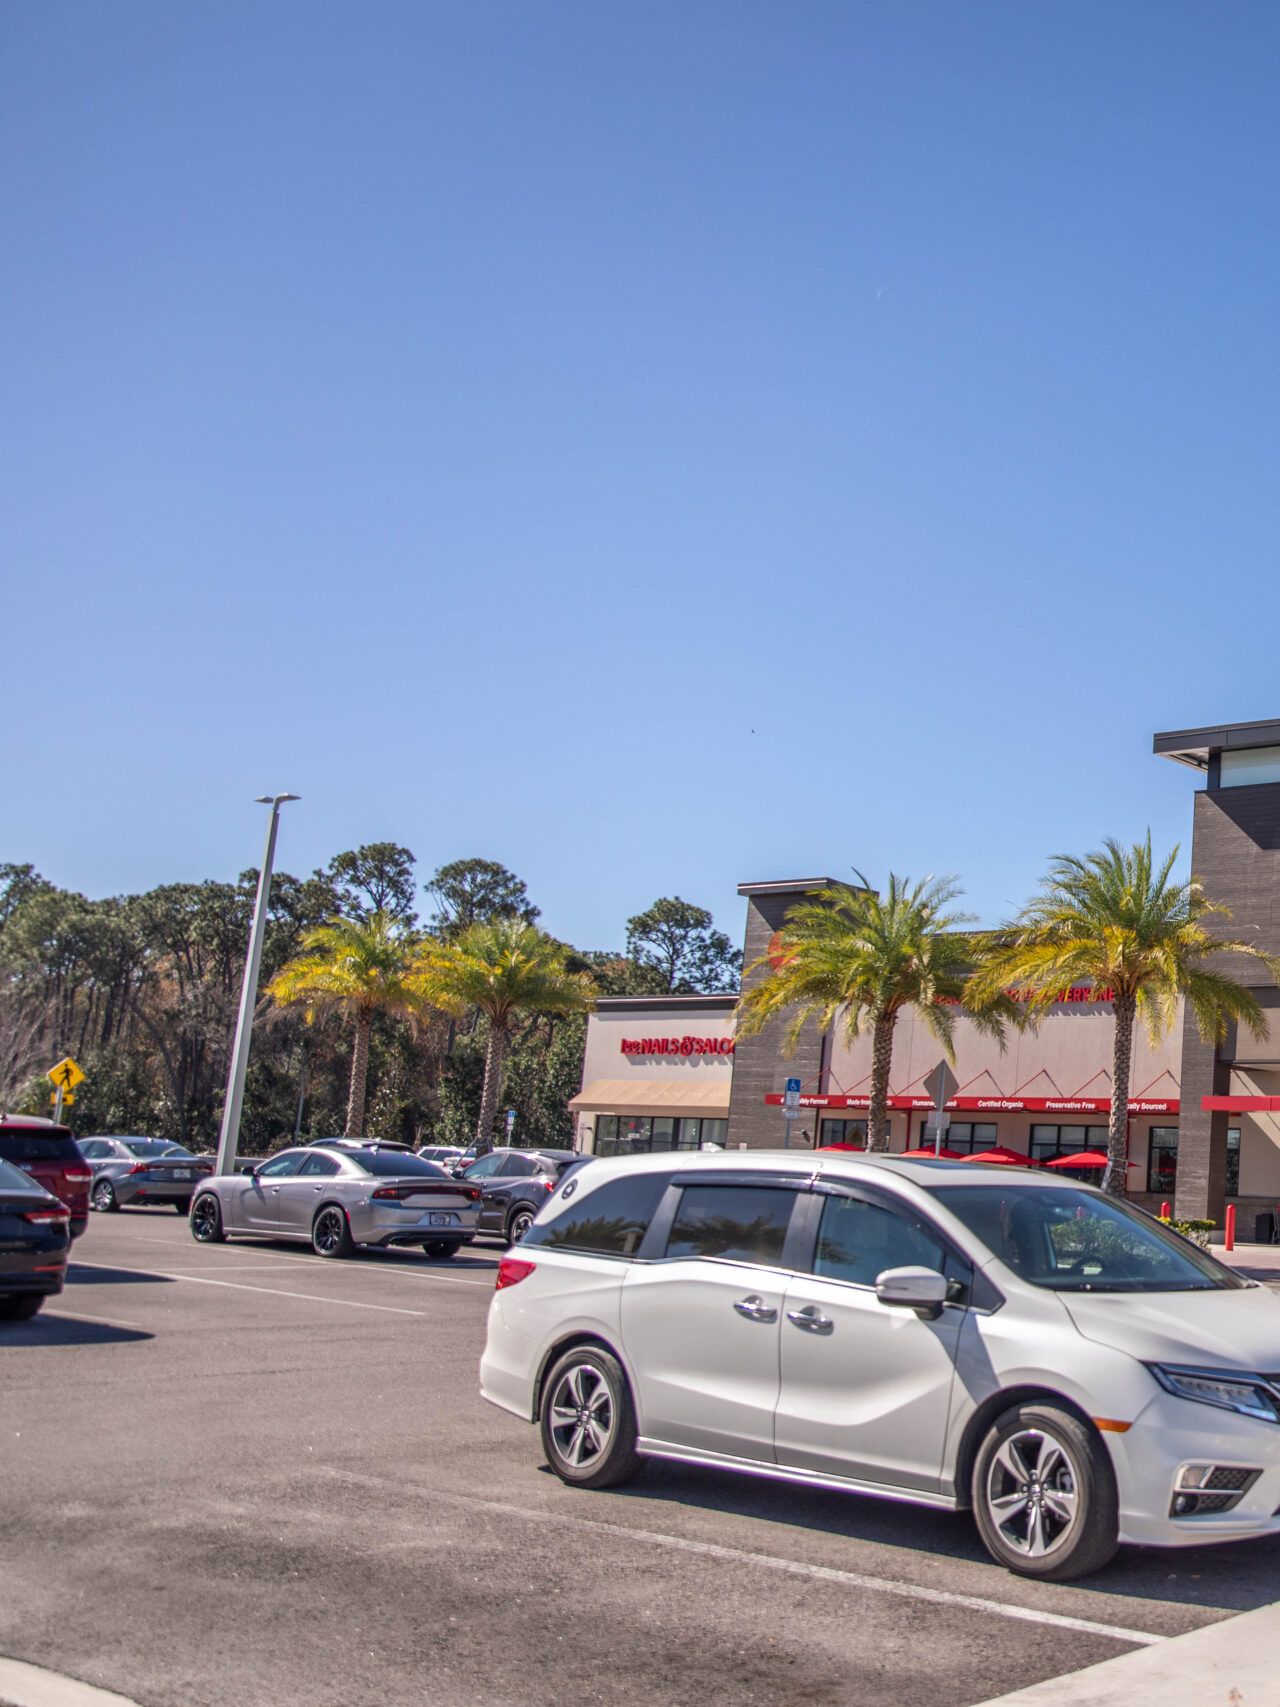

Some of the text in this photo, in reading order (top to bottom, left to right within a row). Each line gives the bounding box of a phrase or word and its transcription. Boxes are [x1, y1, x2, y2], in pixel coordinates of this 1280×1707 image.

[641, 1038, 679, 1055] NAILS
[695, 1038, 736, 1055] SALO
[977, 1100, 1024, 1109] Certified Organic
[1045, 1101, 1096, 1109] Preservative Free
[1141, 1102, 1167, 1110] Sourced
